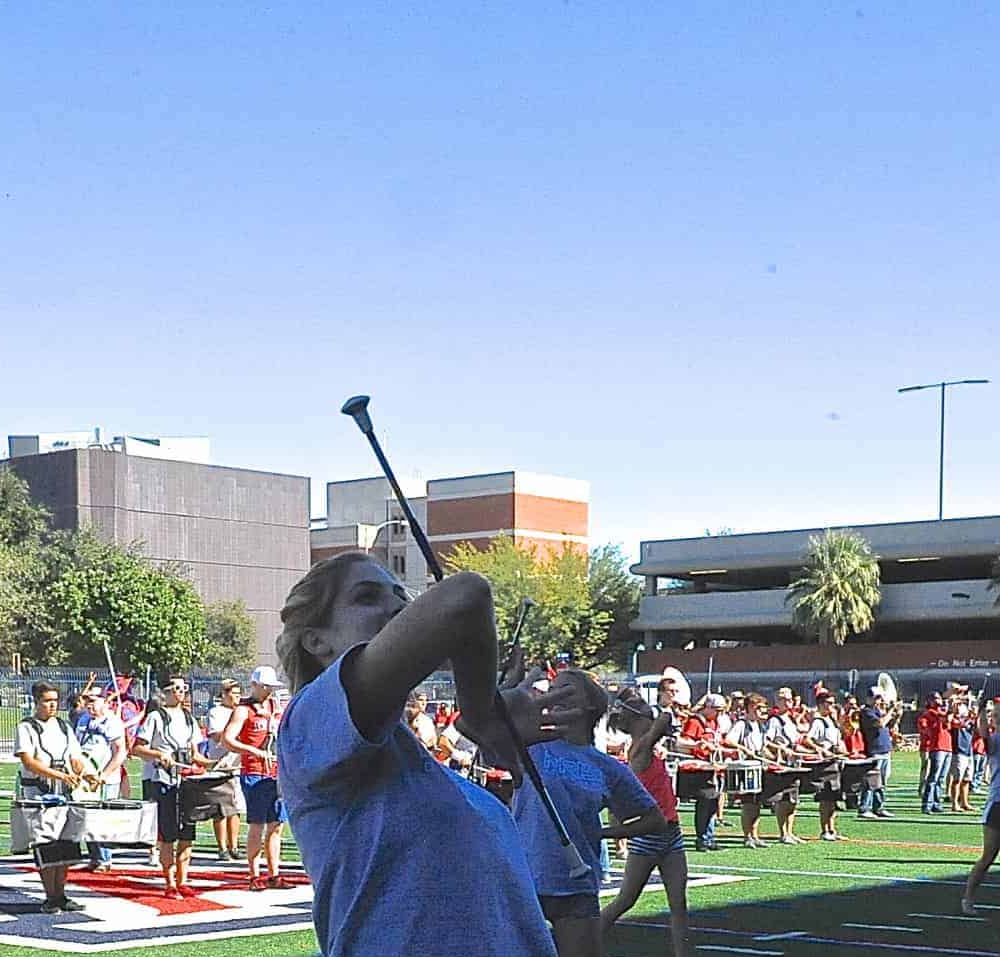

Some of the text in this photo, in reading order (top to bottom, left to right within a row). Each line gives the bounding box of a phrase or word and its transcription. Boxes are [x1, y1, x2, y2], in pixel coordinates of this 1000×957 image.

[937, 658, 990, 668] Do Not Enter
